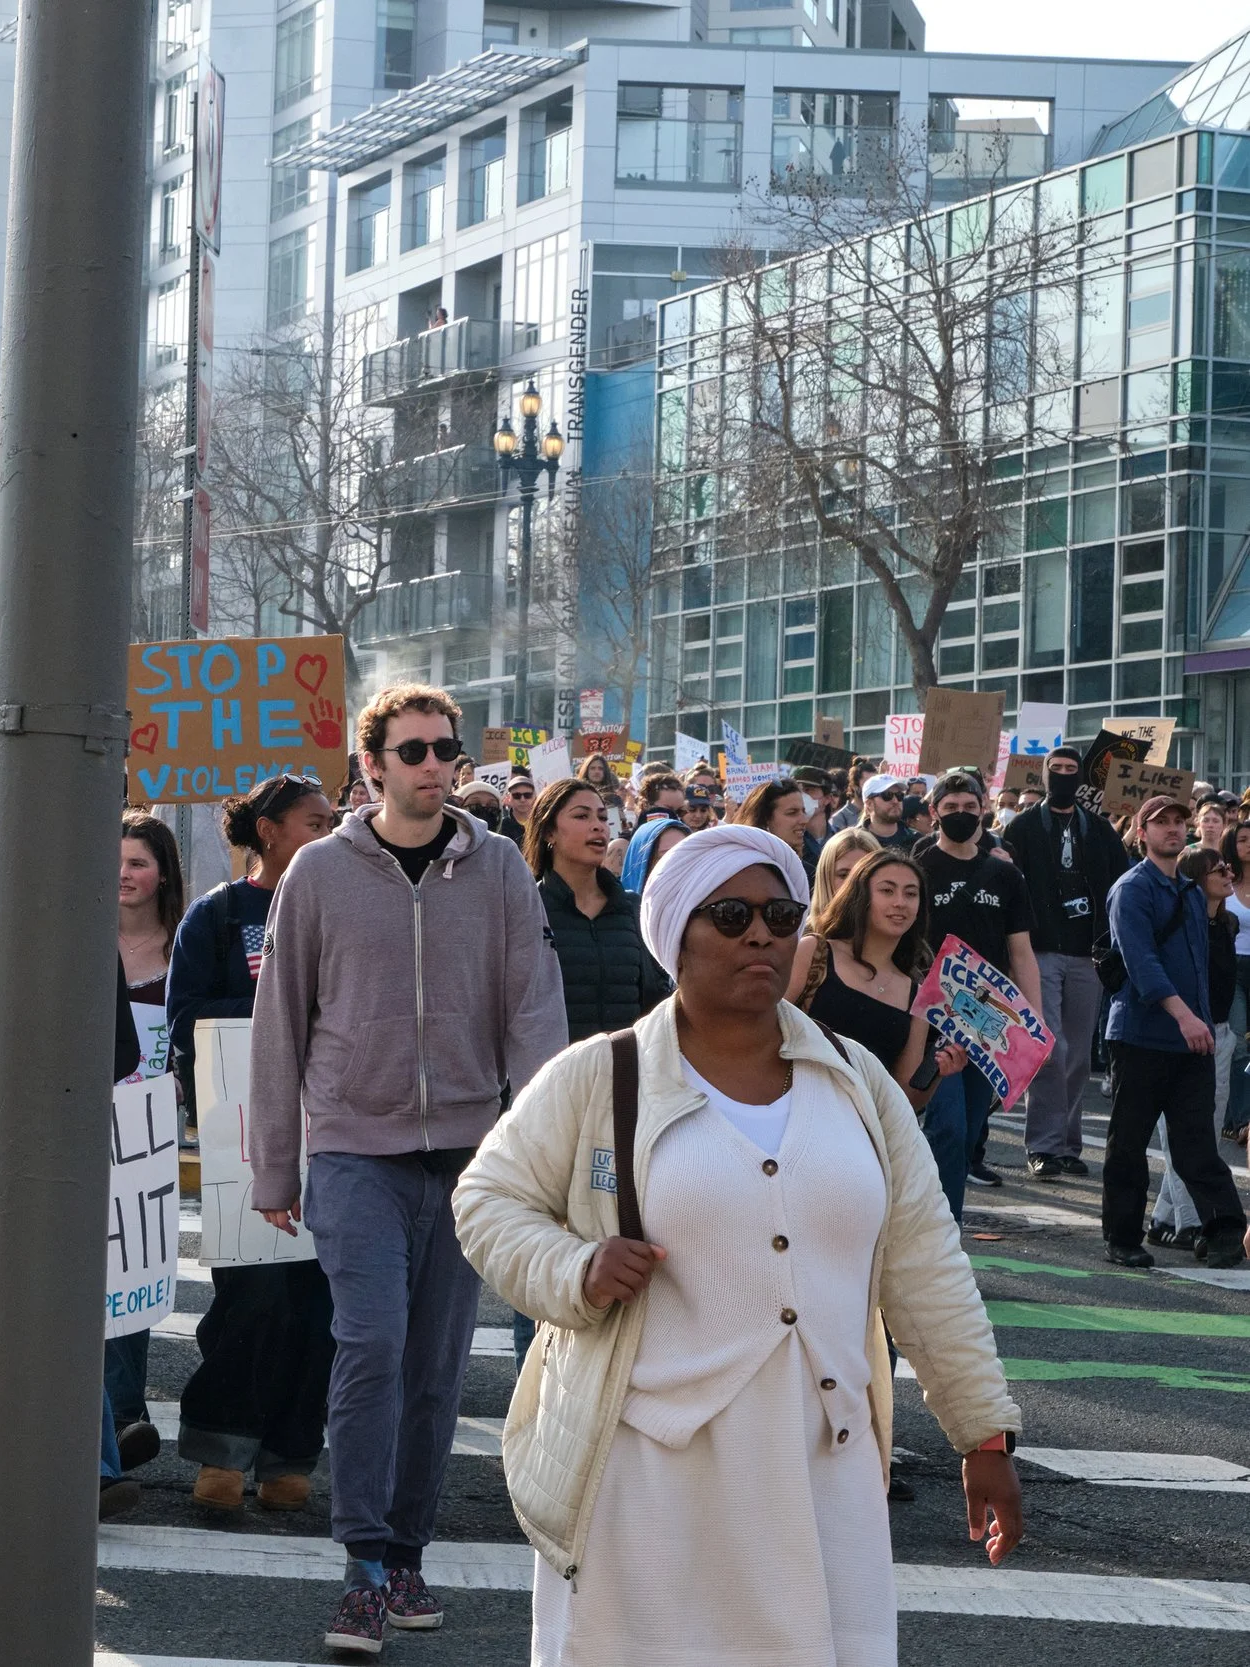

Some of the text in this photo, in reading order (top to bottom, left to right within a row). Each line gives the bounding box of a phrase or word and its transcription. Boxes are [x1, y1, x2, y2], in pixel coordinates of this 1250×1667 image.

[567, 288, 589, 444] TRANSGENDER
[134, 643, 286, 695] STOP
[150, 698, 303, 750] THE
[486, 731, 507, 740] ICE
[578, 724, 625, 736] LIBERATION
[890, 717, 923, 734] STO
[1138, 726, 1156, 738] THE
[512, 728, 541, 746] ICE
[750, 763, 774, 773] LIAM
[888, 763, 920, 778] TAKEO
[1117, 764, 1183, 789] I LIKE
[1075, 784, 1096, 800] CE
[1122, 785, 1149, 800] MY
[942, 959, 980, 991] ICE
[956, 944, 1046, 1044] I LIKE MY
[927, 1008, 1010, 1099] CRUSHED
[111, 1092, 175, 1166] LL
[107, 1181, 175, 1273] HIT
[105, 1275, 171, 1319] PEOPLE!
